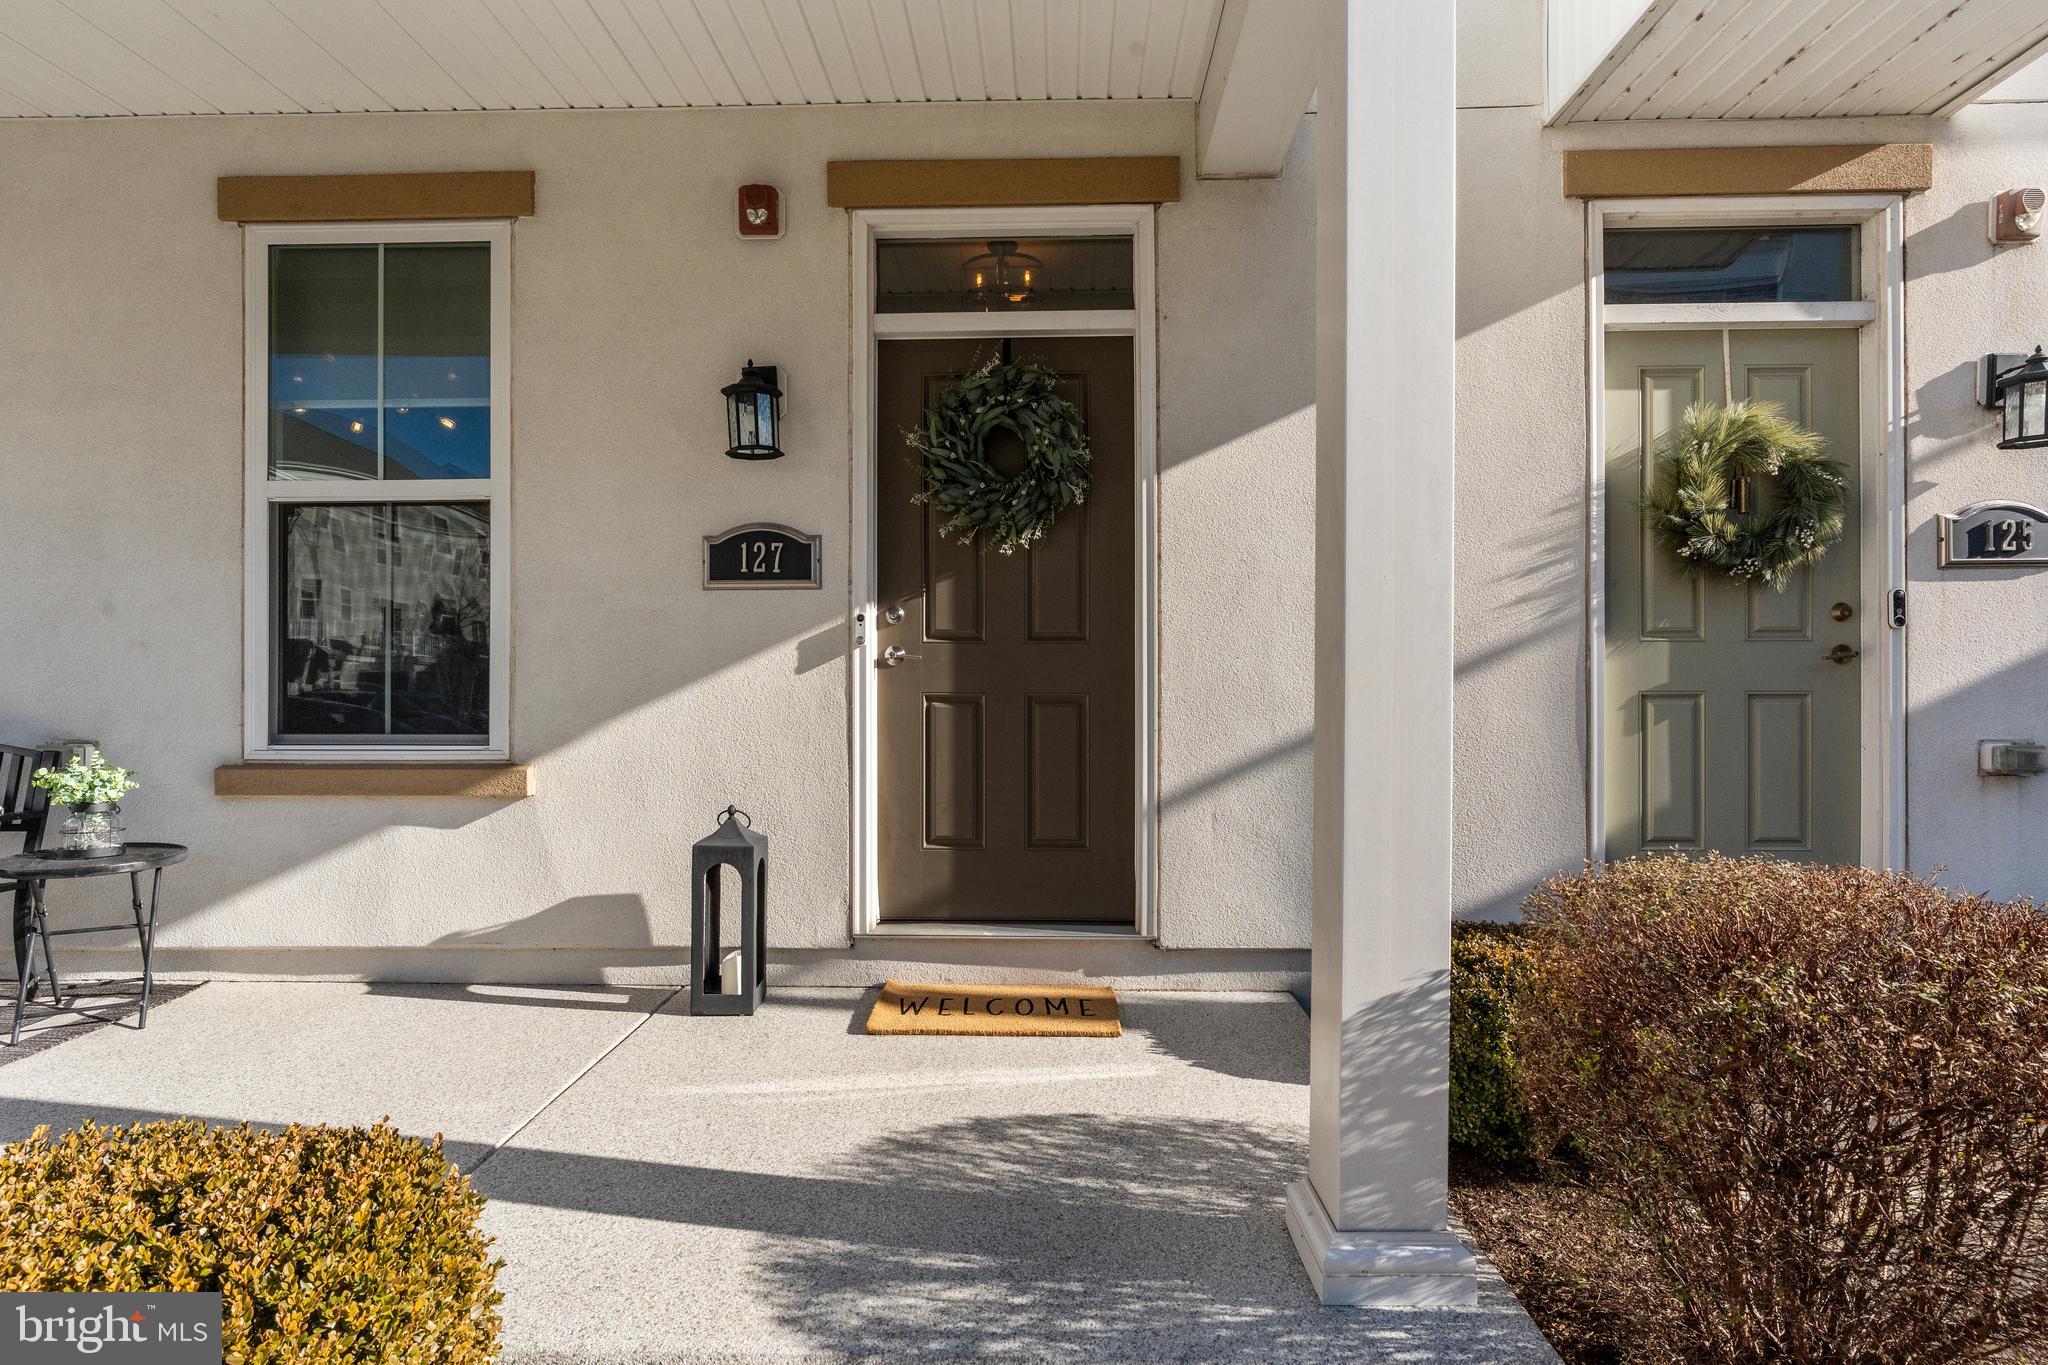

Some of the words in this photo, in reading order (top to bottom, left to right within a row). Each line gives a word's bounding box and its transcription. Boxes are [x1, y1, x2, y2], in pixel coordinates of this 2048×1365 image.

[1984, 519, 2033, 551] 125
[740, 541, 783, 573] 127
[900, 997, 1097, 1017] WELCOME
